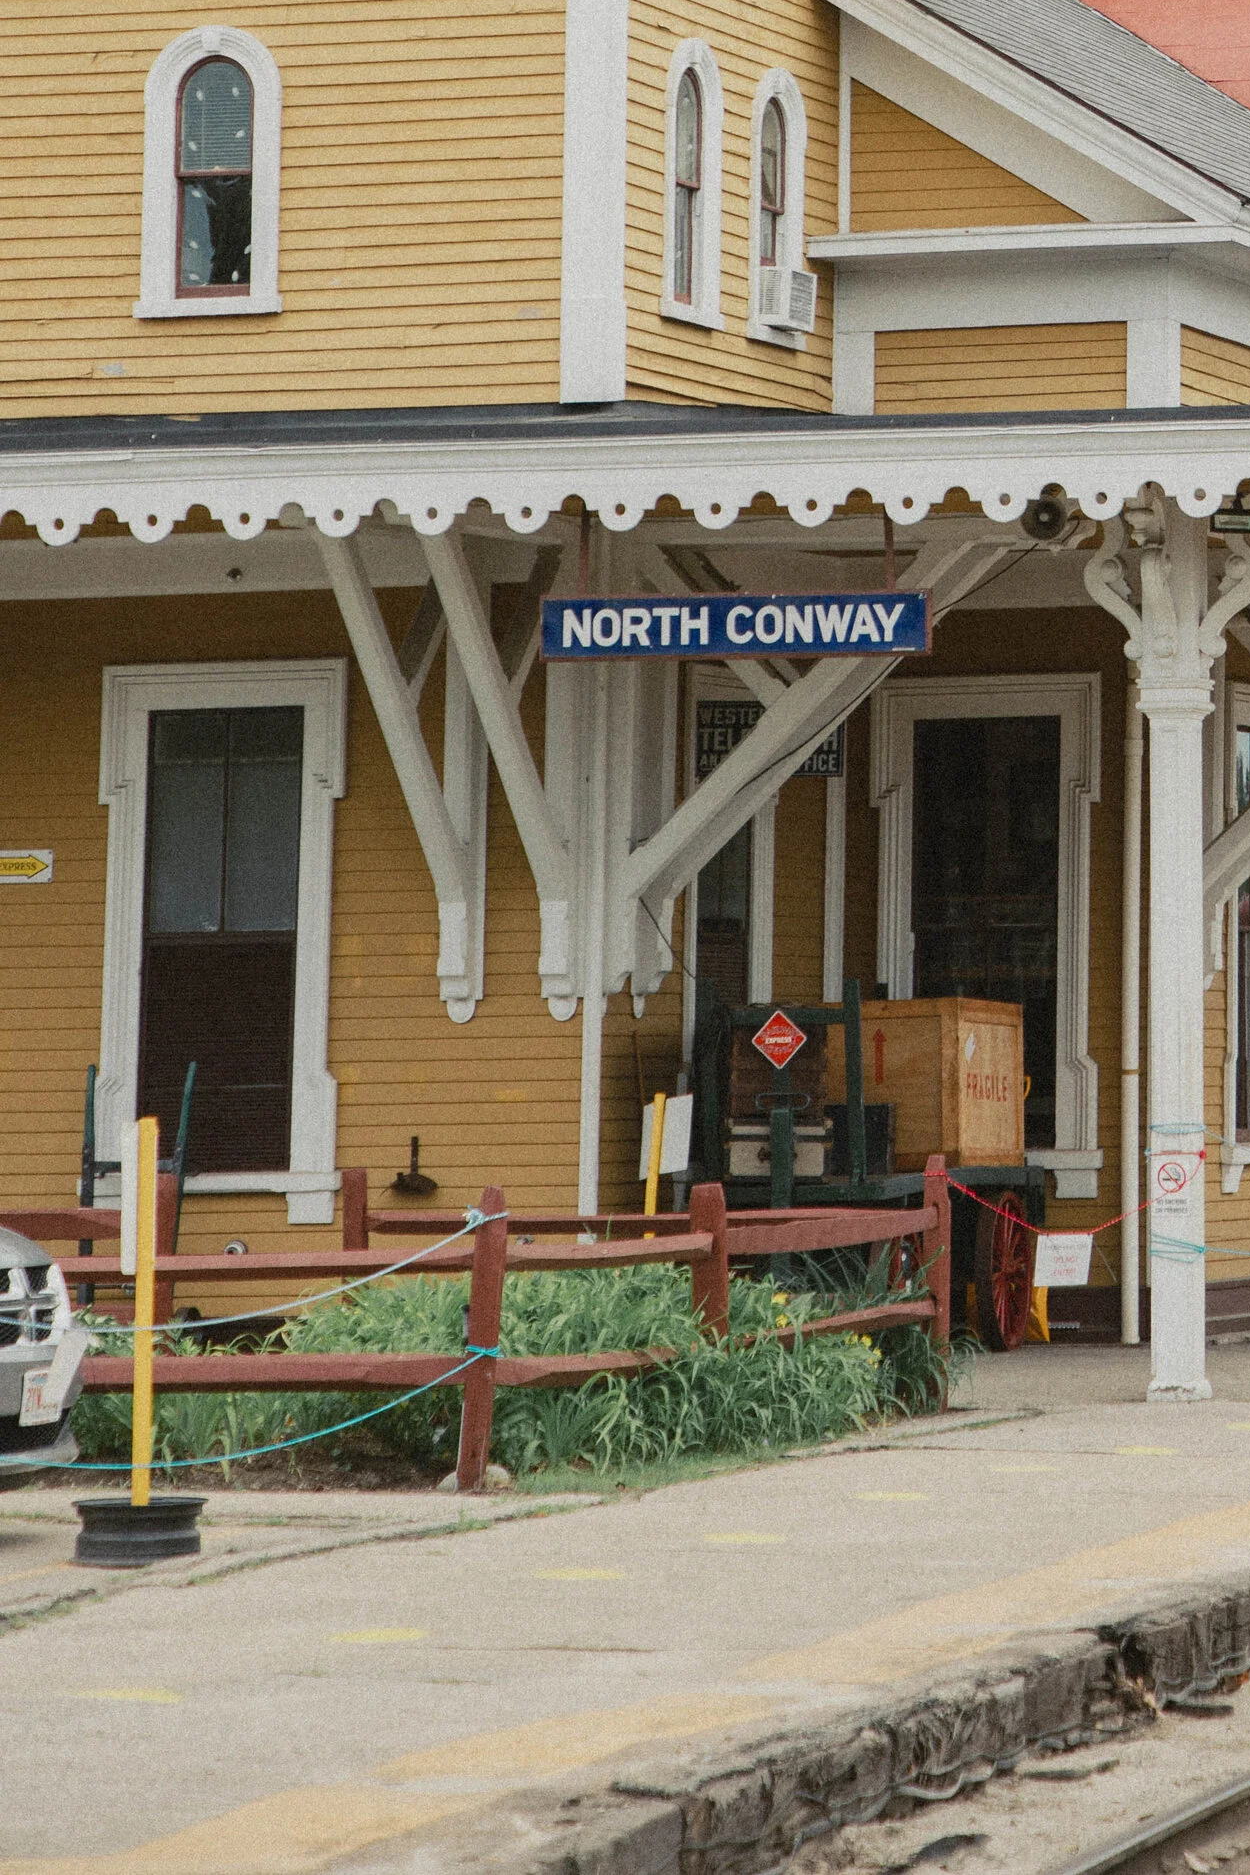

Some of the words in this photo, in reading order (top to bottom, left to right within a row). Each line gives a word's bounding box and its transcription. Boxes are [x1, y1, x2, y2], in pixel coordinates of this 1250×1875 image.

[562, 606, 709, 648] NORTH
[726, 603, 905, 644] CONWAY
[699, 708, 765, 725] WESTE
[805, 754, 838, 771] FICE
[967, 1072, 1008, 1102] FRAGILE
